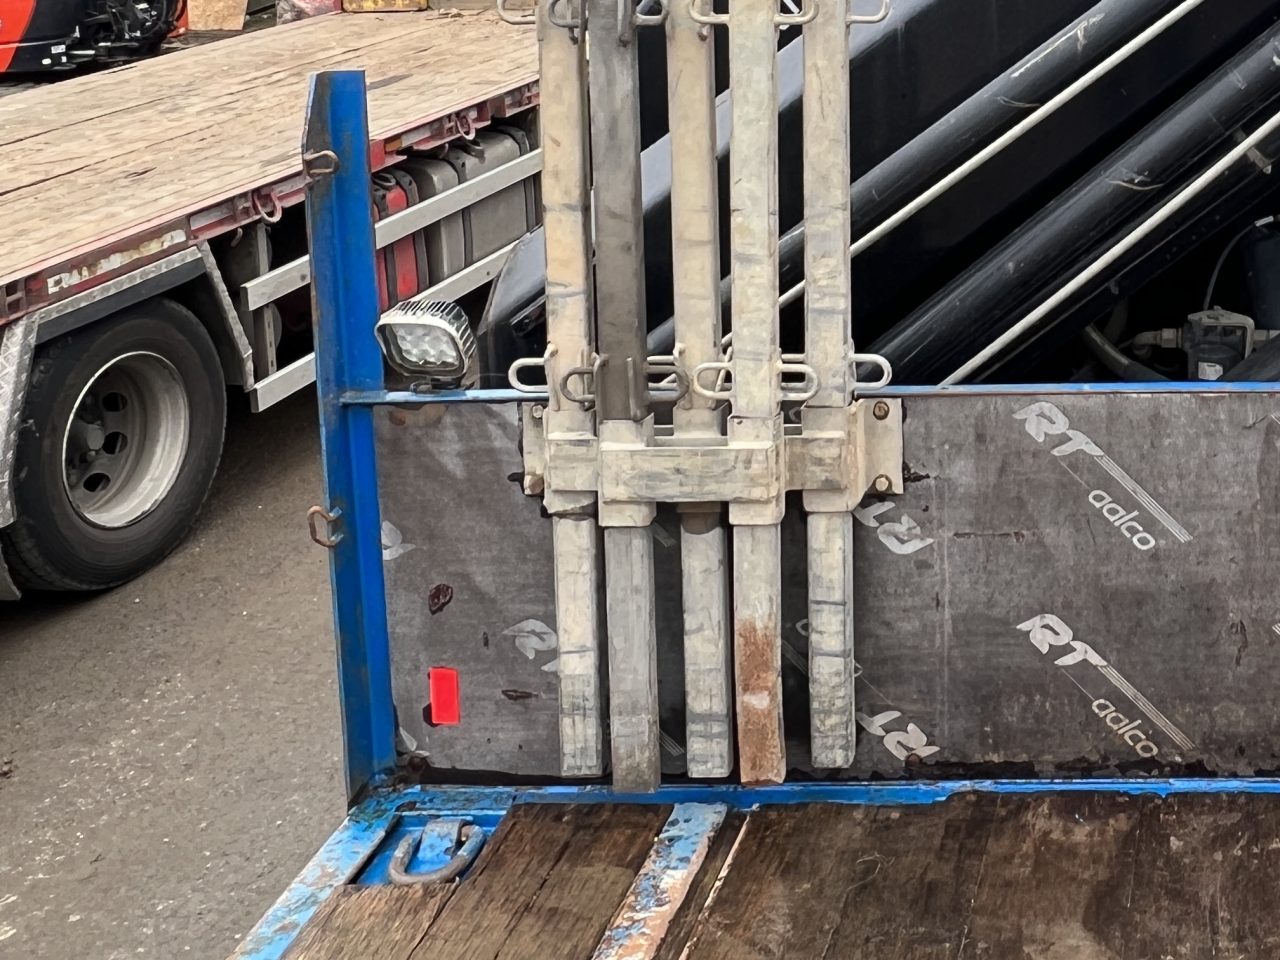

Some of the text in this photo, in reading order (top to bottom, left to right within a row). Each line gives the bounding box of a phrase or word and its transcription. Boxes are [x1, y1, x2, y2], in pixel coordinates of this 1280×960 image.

[1013, 401, 1105, 456] RT
[1088, 490, 1156, 551] aalco
[1016, 613, 1108, 666] RT
[1091, 698, 1159, 758] aalco
